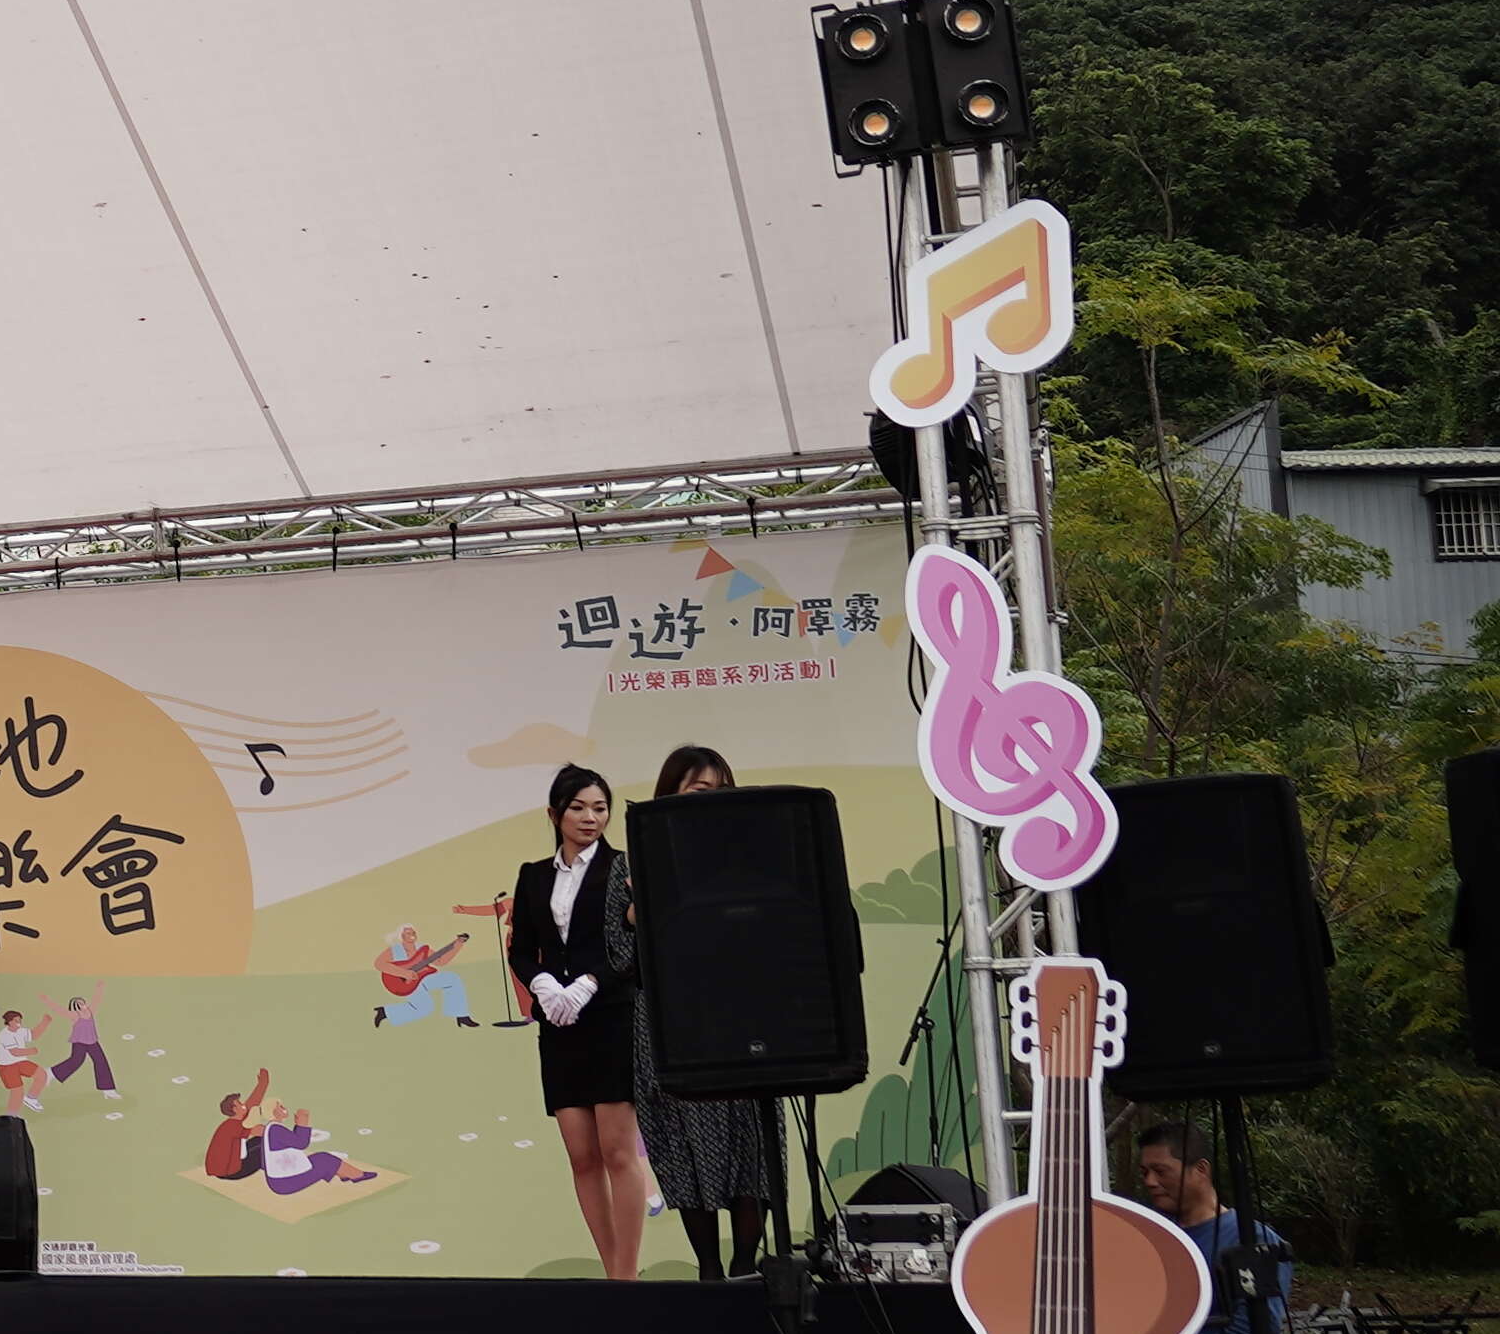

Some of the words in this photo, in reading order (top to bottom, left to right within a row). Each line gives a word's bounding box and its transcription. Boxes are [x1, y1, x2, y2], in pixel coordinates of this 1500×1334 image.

[619, 660, 822, 692] 光榮再臨系列活動
